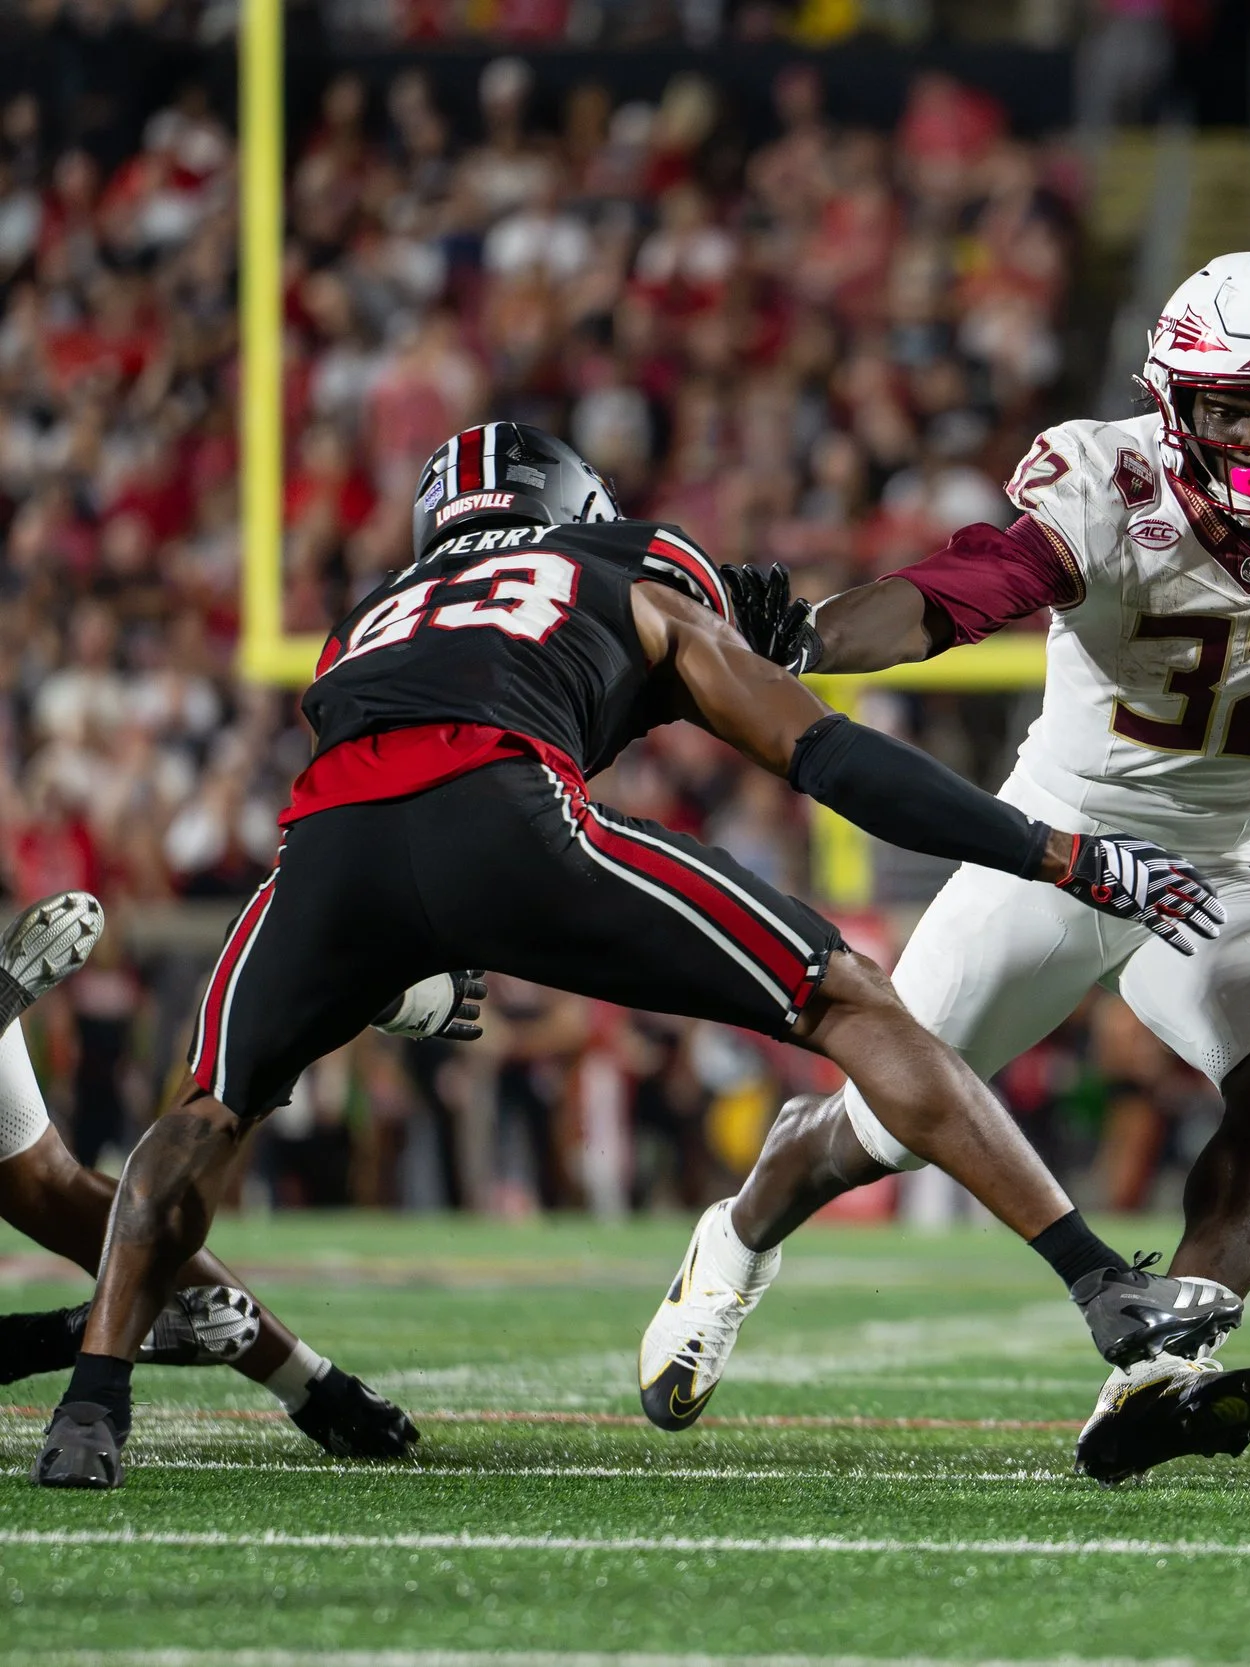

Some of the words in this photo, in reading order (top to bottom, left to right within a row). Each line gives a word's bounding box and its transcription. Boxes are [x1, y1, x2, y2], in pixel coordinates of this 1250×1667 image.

[436, 493, 515, 529] LOUISVILLE
[426, 524, 562, 565] PERRY
[1135, 526, 1172, 539] ACC
